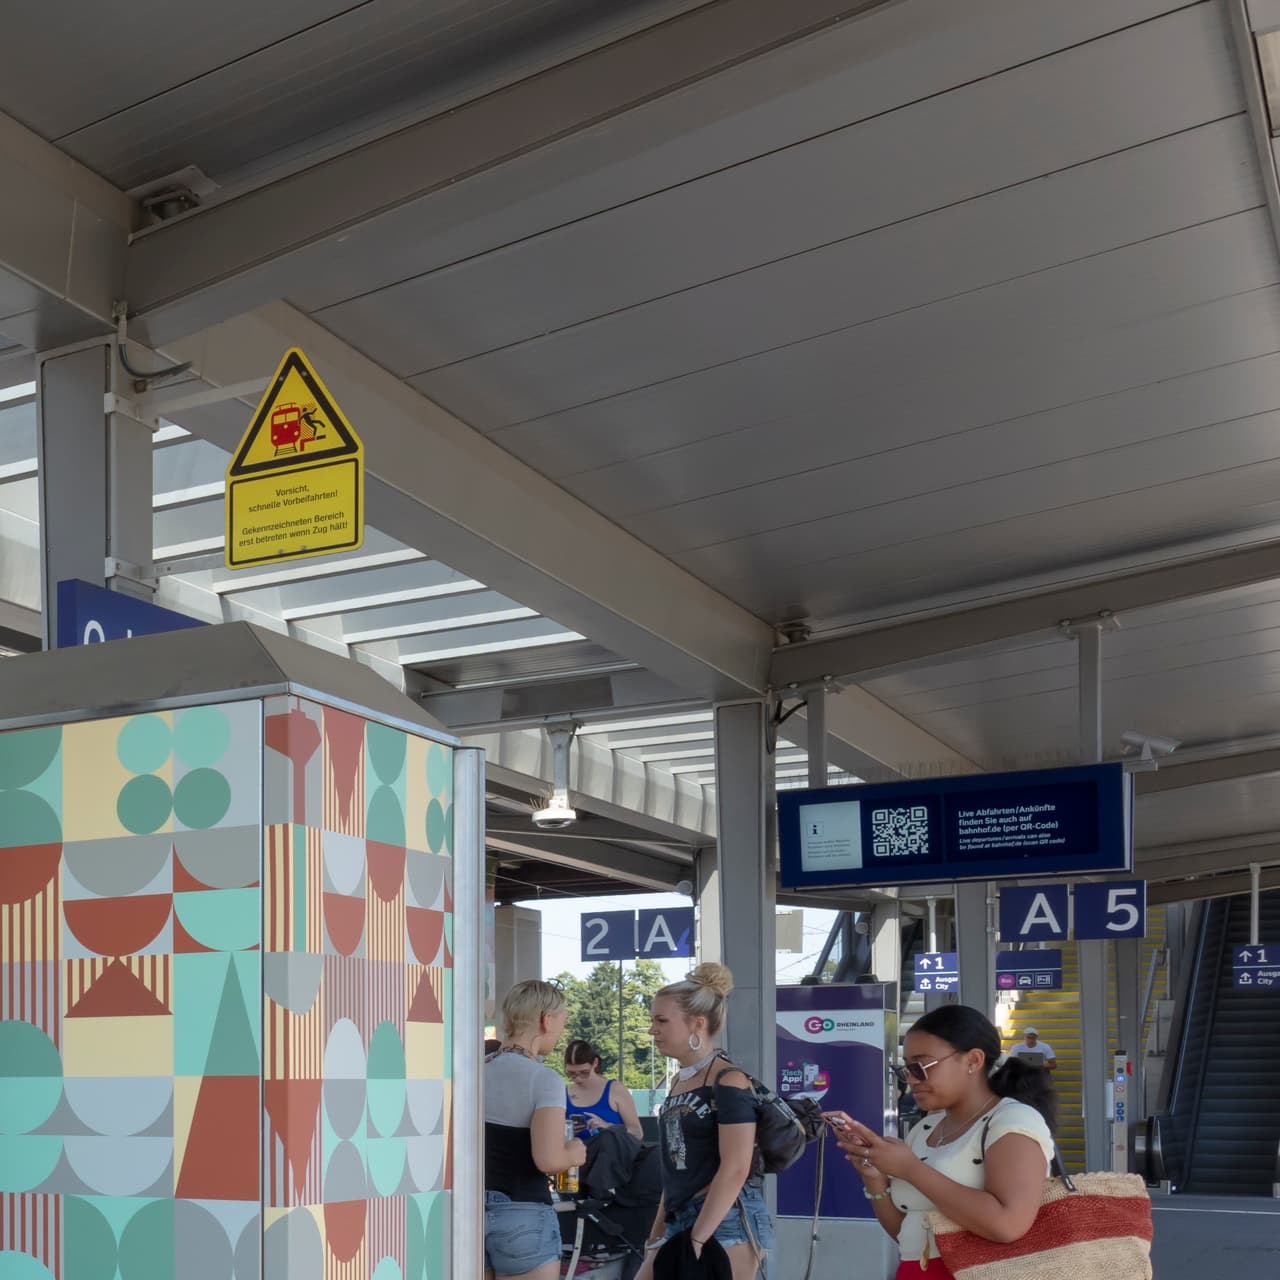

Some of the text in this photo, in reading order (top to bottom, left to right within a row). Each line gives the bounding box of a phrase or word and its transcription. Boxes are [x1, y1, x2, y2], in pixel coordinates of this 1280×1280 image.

[275, 484, 310, 497] Vorsicht,
[248, 489, 338, 512] schnelle Vorbeifahrten!
[242, 511, 345, 536] Gekennzeichneten Bereich
[239, 521, 348, 547] erst betreten wenn Zug hält!
[958, 810, 975, 818] Live
[959, 818, 984, 827] finden
[998, 815, 1018, 824] auch
[1018, 813, 1033, 822] auf
[959, 820, 1059, 835] bahnhof.de (per QR-Code)
[1019, 887, 1140, 935] A 5
[584, 914, 678, 955] 2 A
[1257, 948, 1268, 963] 1
[935, 956, 945, 970] 1
[935, 976, 959, 984] Ausga
[1257, 970, 1280, 978] Ausga
[935, 982, 949, 991] City
[1257, 977, 1274, 986] City
[782, 1069, 803, 1077] Zisch
[782, 1075, 803, 1084] App!
